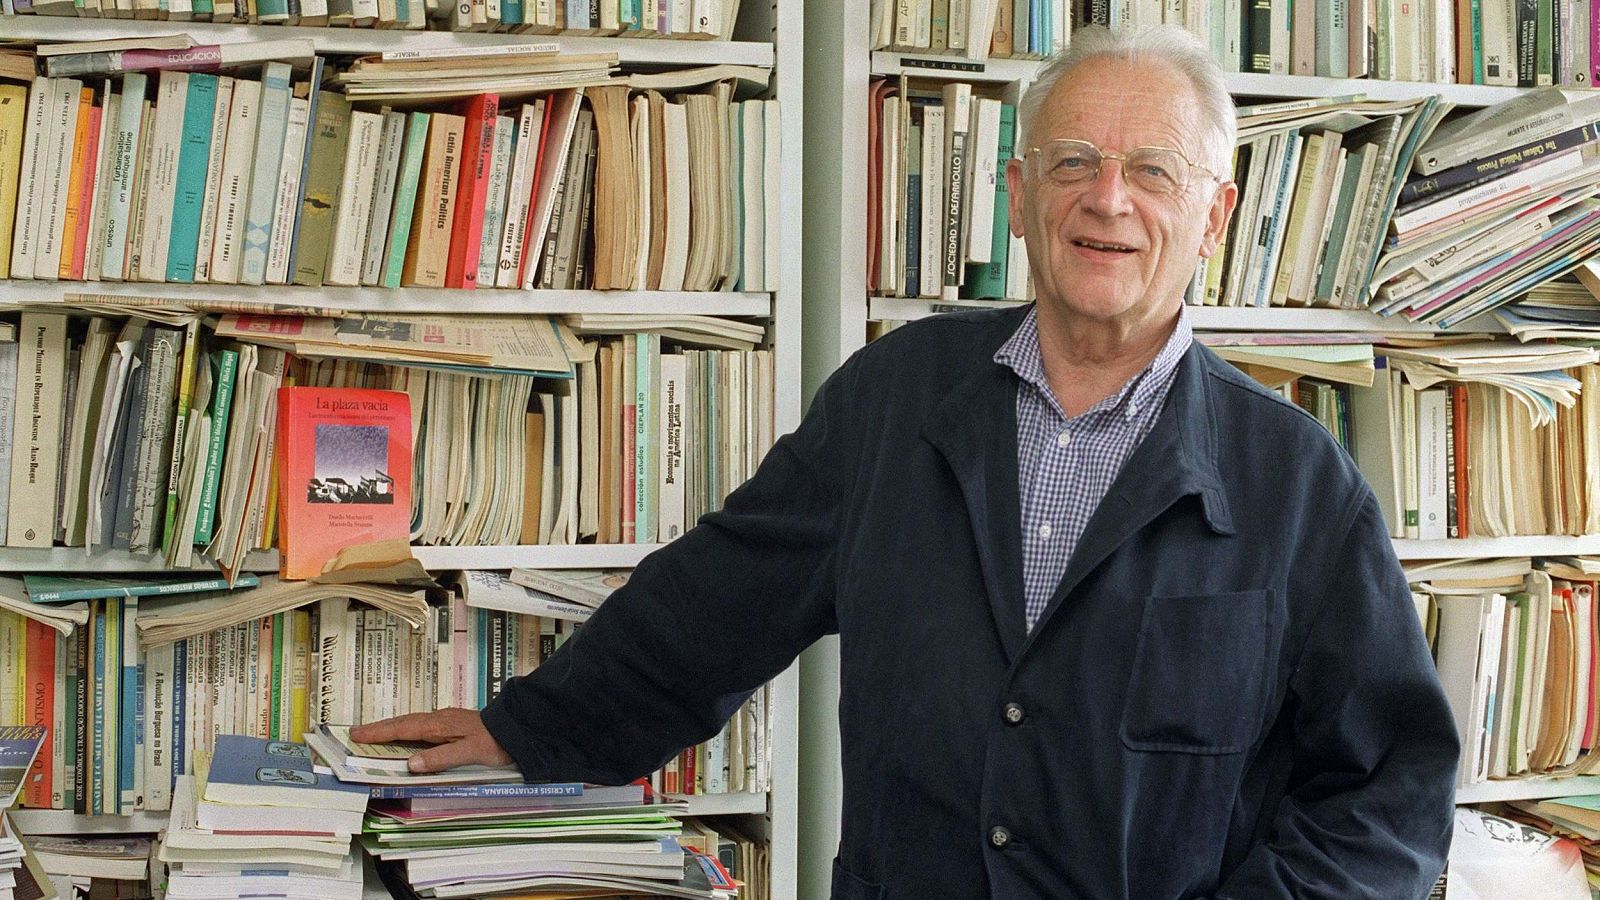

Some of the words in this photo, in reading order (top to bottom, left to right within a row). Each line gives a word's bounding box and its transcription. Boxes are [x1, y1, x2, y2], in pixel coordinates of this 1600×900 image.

[168, 52, 220, 62] EDUCACION
[911, 60, 976, 70] MEXIQUE
[522, 116, 530, 138] LATINA
[1507, 124, 1525, 136] MUERTE
[124, 132, 133, 152] latine
[447, 132, 456, 153] Latin
[1523, 145, 1544, 157] Chilean
[1545, 140, 1556, 150] The
[113, 131, 125, 182] l'urbanisation
[209, 142, 220, 190] PLANEJAMENTO
[1477, 160, 1498, 172] Process
[1499, 152, 1522, 167] Political
[120, 155, 131, 190] amérique
[441, 156, 453, 195] American
[1272, 200, 1282, 228] CIEPLAN
[1285, 135, 1295, 161] especial
[950, 157, 961, 215] DESARROLLO
[119, 193, 125, 202] en
[208, 192, 215, 202] DO
[490, 182, 500, 214] American
[437, 198, 448, 229] Politics
[106, 219, 115, 248] unesco
[487, 216, 497, 246] Societies
[506, 223, 514, 243] CRISIS
[203, 239, 209, 247] OS
[505, 243, 511, 253] LA
[947, 229, 957, 276] SOCIEDAD
[224, 352, 234, 366] Sigal
[316, 397, 329, 409] La
[332, 398, 359, 412] plaza
[638, 393, 644, 401] 20
[214, 418, 223, 435] década
[209, 450, 218, 464] poder
[666, 451, 674, 484] Economia
[204, 470, 215, 502] Intelectuales
[215, 646, 220, 654] NA
[493, 618, 501, 678] CONSTITUINTE
[322, 644, 338, 692] Miracle
[249, 665, 257, 694] L'esprit
[493, 681, 500, 692] NA
[154, 679, 164, 708] Revolução
[153, 710, 163, 738] Burguesa
[259, 708, 267, 735] Estado
[77, 718, 85, 747] TRANSIÇÃO
[154, 750, 162, 766] Brasil
[482, 787, 538, 795] ECUATORIANA:
